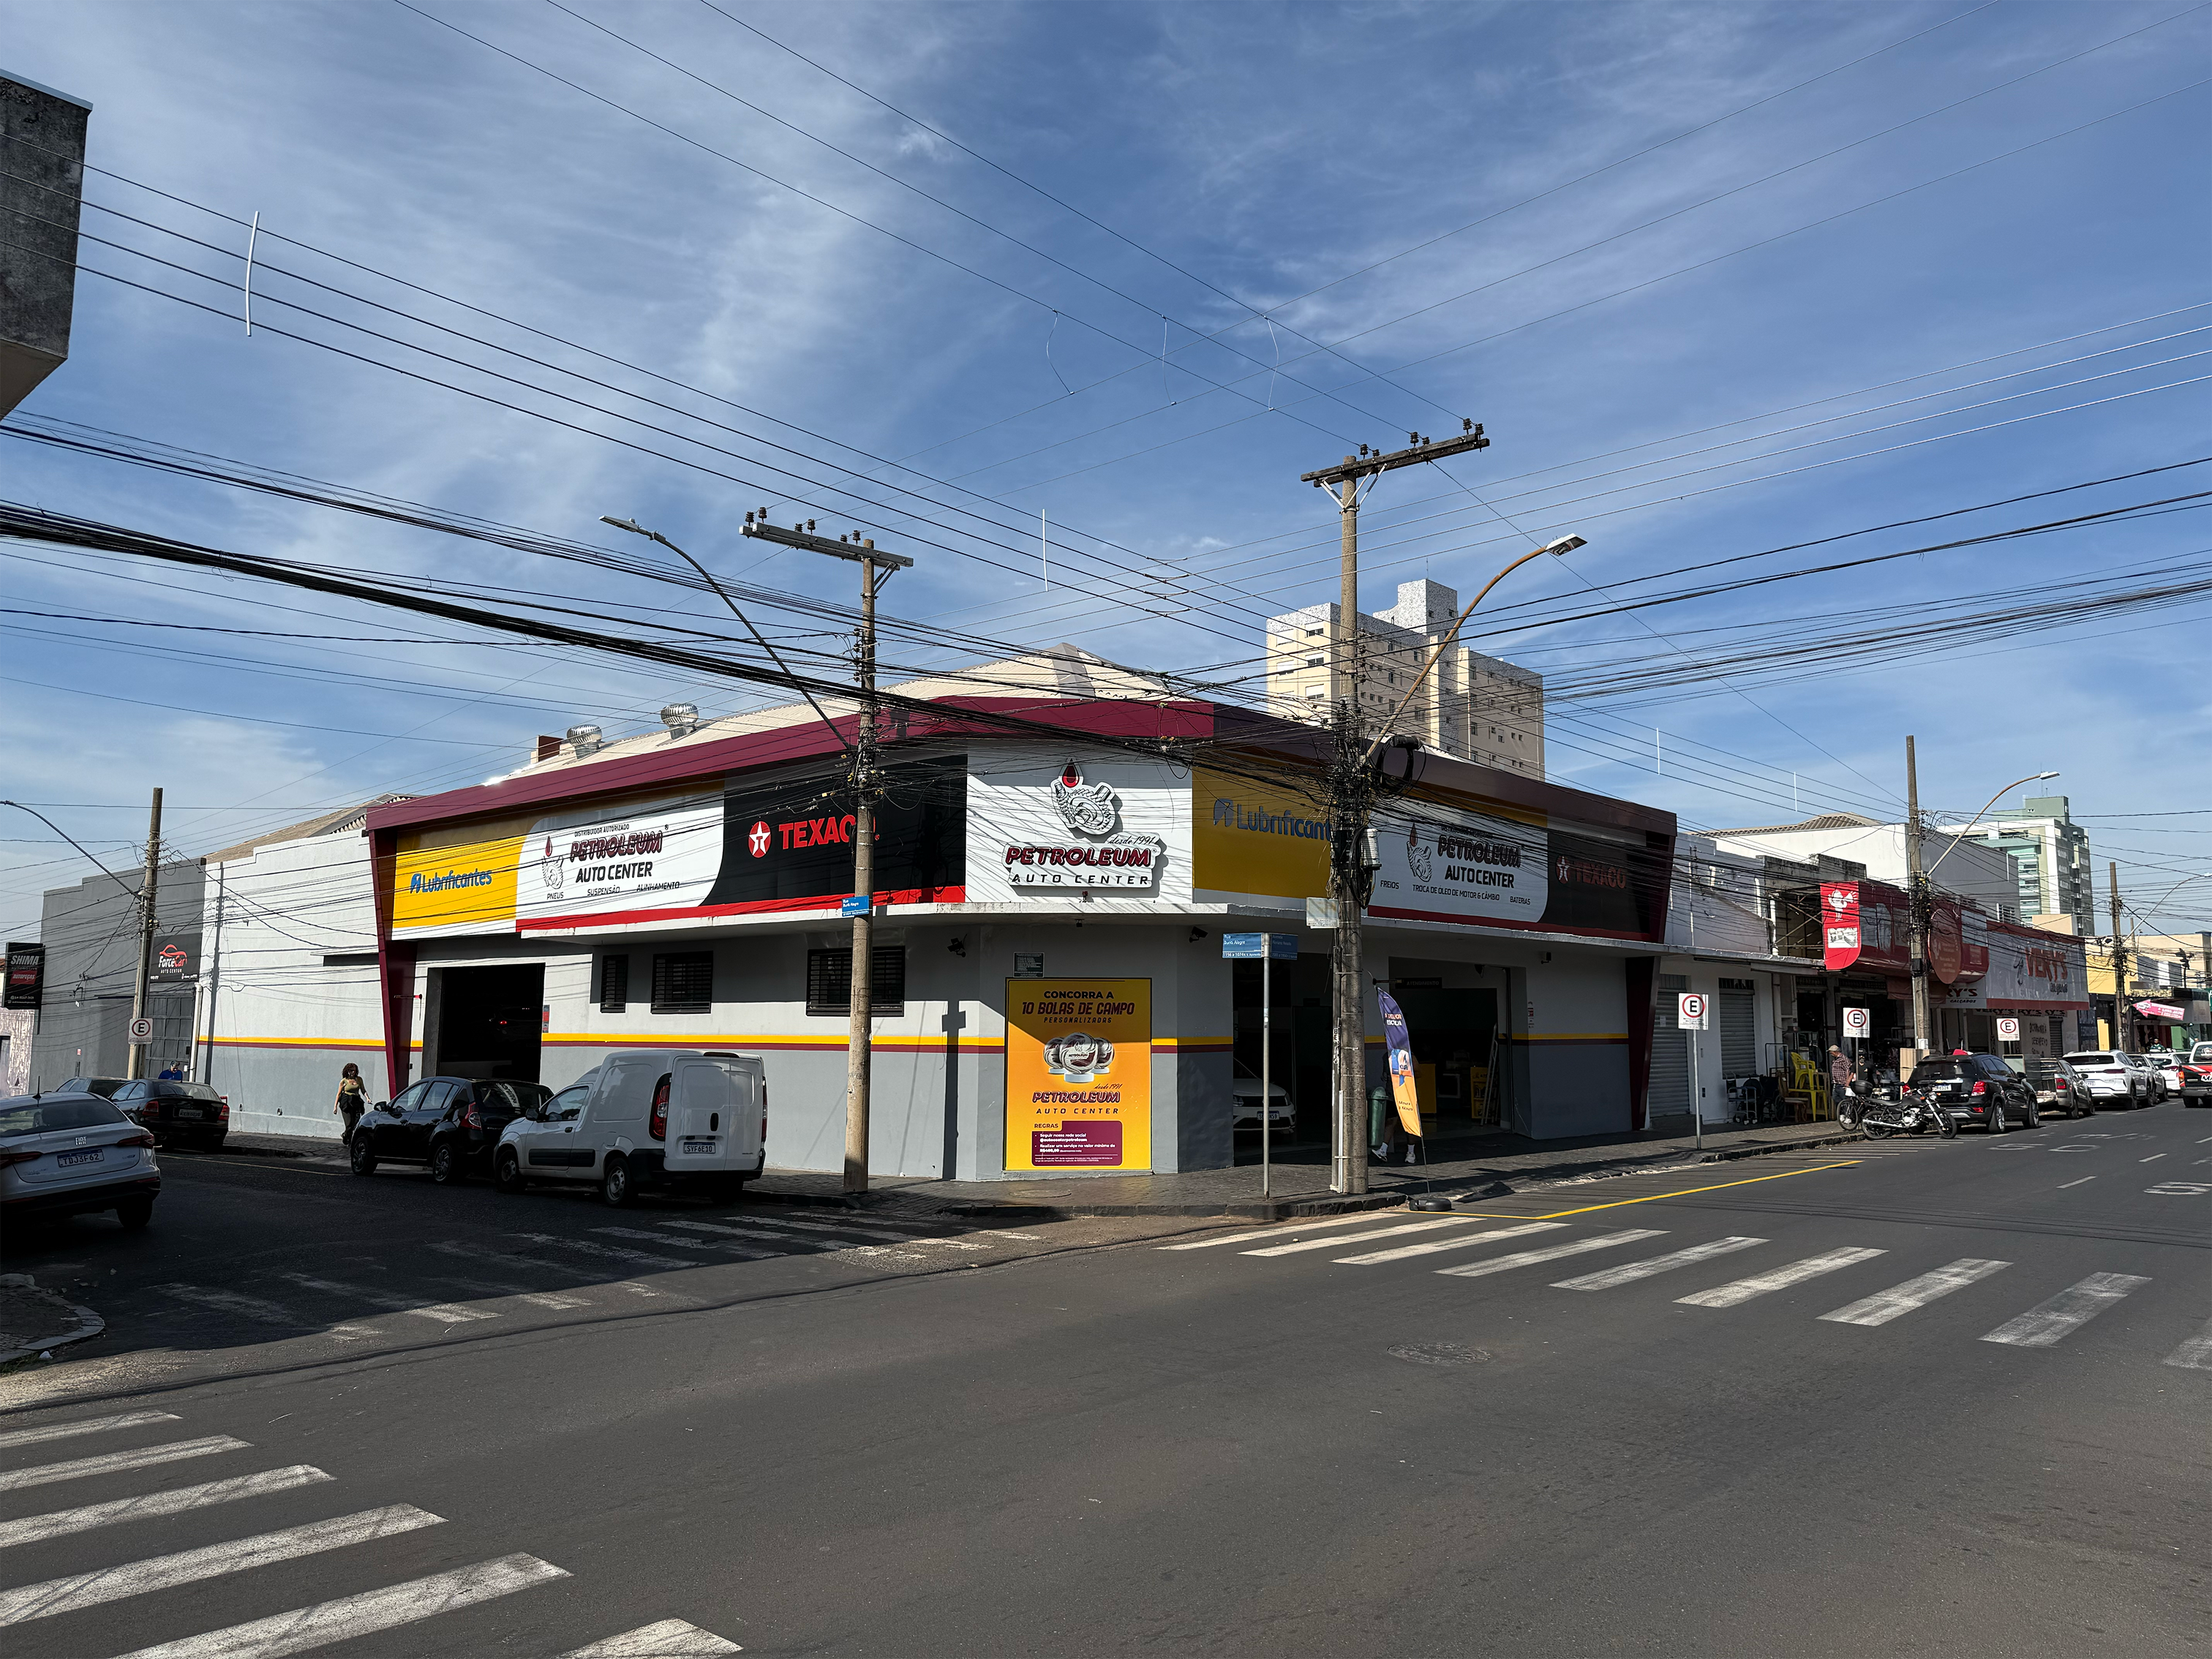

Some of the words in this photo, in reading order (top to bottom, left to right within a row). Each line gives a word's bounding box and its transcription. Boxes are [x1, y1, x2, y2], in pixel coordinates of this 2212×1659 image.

[1237, 803, 1331, 841] Lubrificant
[603, 824, 630, 833] AUTORIZADO
[779, 814, 876, 849] TEXAC
[1108, 835, 1132, 845] desde
[1134, 836, 1155, 845] 1991
[570, 830, 663, 863] PETROLEUM
[1437, 835, 1521, 868] PETROLEUM
[1005, 846, 1152, 867] PETROLEUM
[575, 866, 606, 884] AUTO
[608, 861, 653, 881] CENTER
[1445, 865, 1475, 883] AUTO
[1474, 869, 1515, 889] CENTER
[422, 868, 492, 893] Lubrificantes
[1012, 873, 1061, 883] AUTO
[1075, 874, 1148, 885] CENTER
[1380, 880, 1399, 889] FREIOS
[587, 884, 620, 897] SUSPENSÃO
[636, 881, 680, 892] ALINHAMENTO
[1412, 884, 1429, 893] TROCA
[1438, 885, 1451, 895] ÓLEO
[1452, 889, 1459, 897] DE
[1459, 889, 1477, 899] MOTOR
[1481, 889, 1500, 900] CÂMBIO
[546, 892, 564, 900] PNEUS
[1510, 896, 1531, 906] BATERIAS
[10, 955, 40, 966] SHIMA
[2025, 947, 2069, 982] VERY'S
[1044, 990, 1104, 999] CONCORRA
[1106, 991, 1114, 999] A
[1022, 1001, 1035, 1015] 10
[1037, 1001, 1075, 1015] BOLAS
[1077, 1001, 1094, 1015] DE
[1096, 1002, 1135, 1015] CAMPO
[1690, 1000, 1698, 1012] E
[1853, 1013, 1861, 1024] E
[138, 1023, 146, 1033] E
[2005, 1022, 2012, 1031] E
[1032, 1091, 1121, 1103] PETROLEUM
[75, 1136, 87, 1146] FIAT
[63, 1154, 99, 1165] TDJ3F62
